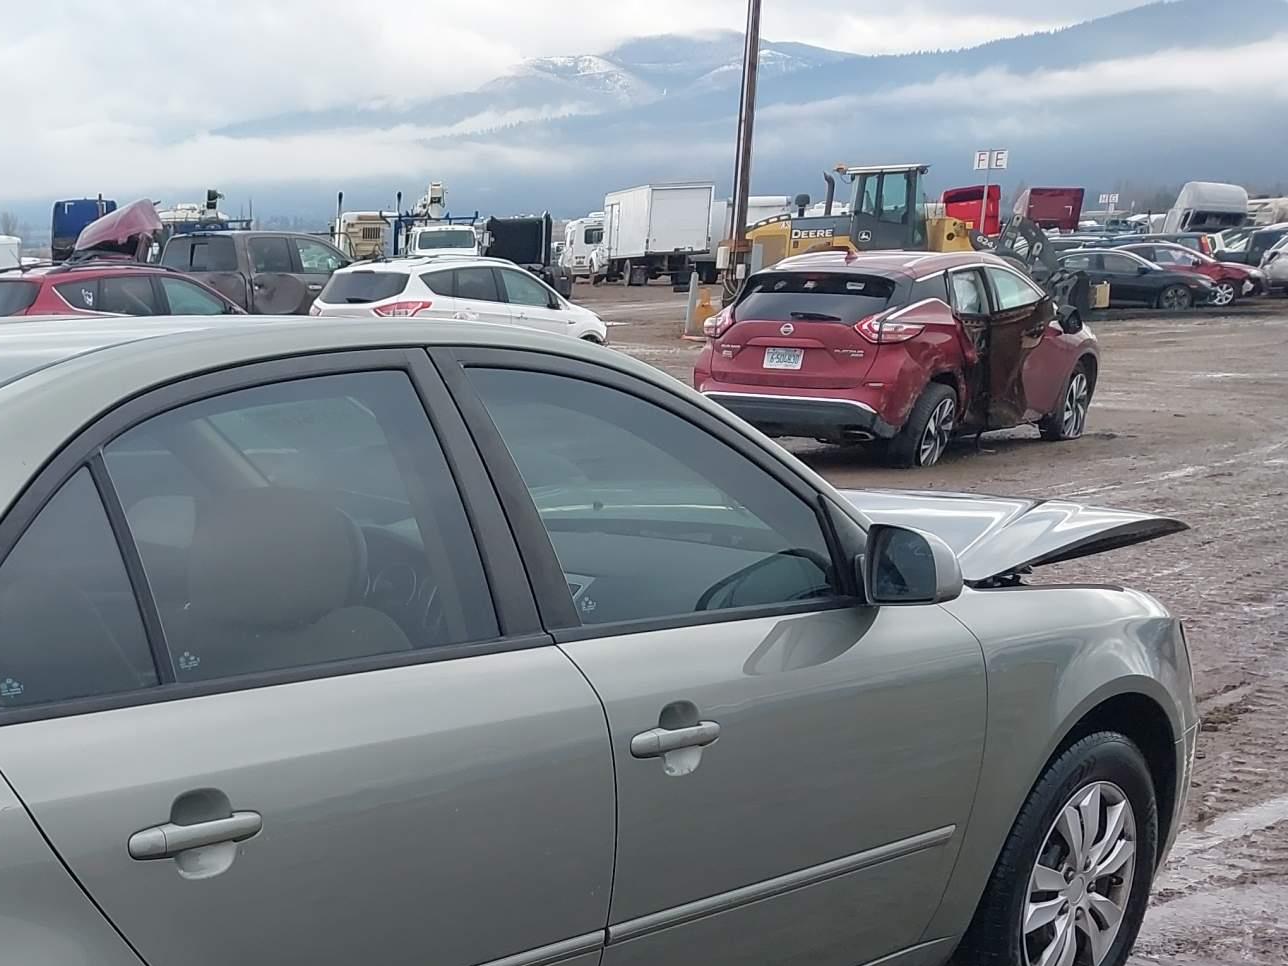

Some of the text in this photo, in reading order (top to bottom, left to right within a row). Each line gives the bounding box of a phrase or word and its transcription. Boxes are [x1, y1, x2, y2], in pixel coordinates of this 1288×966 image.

[977, 151, 1004, 168] F E
[792, 229, 833, 239] DEERE
